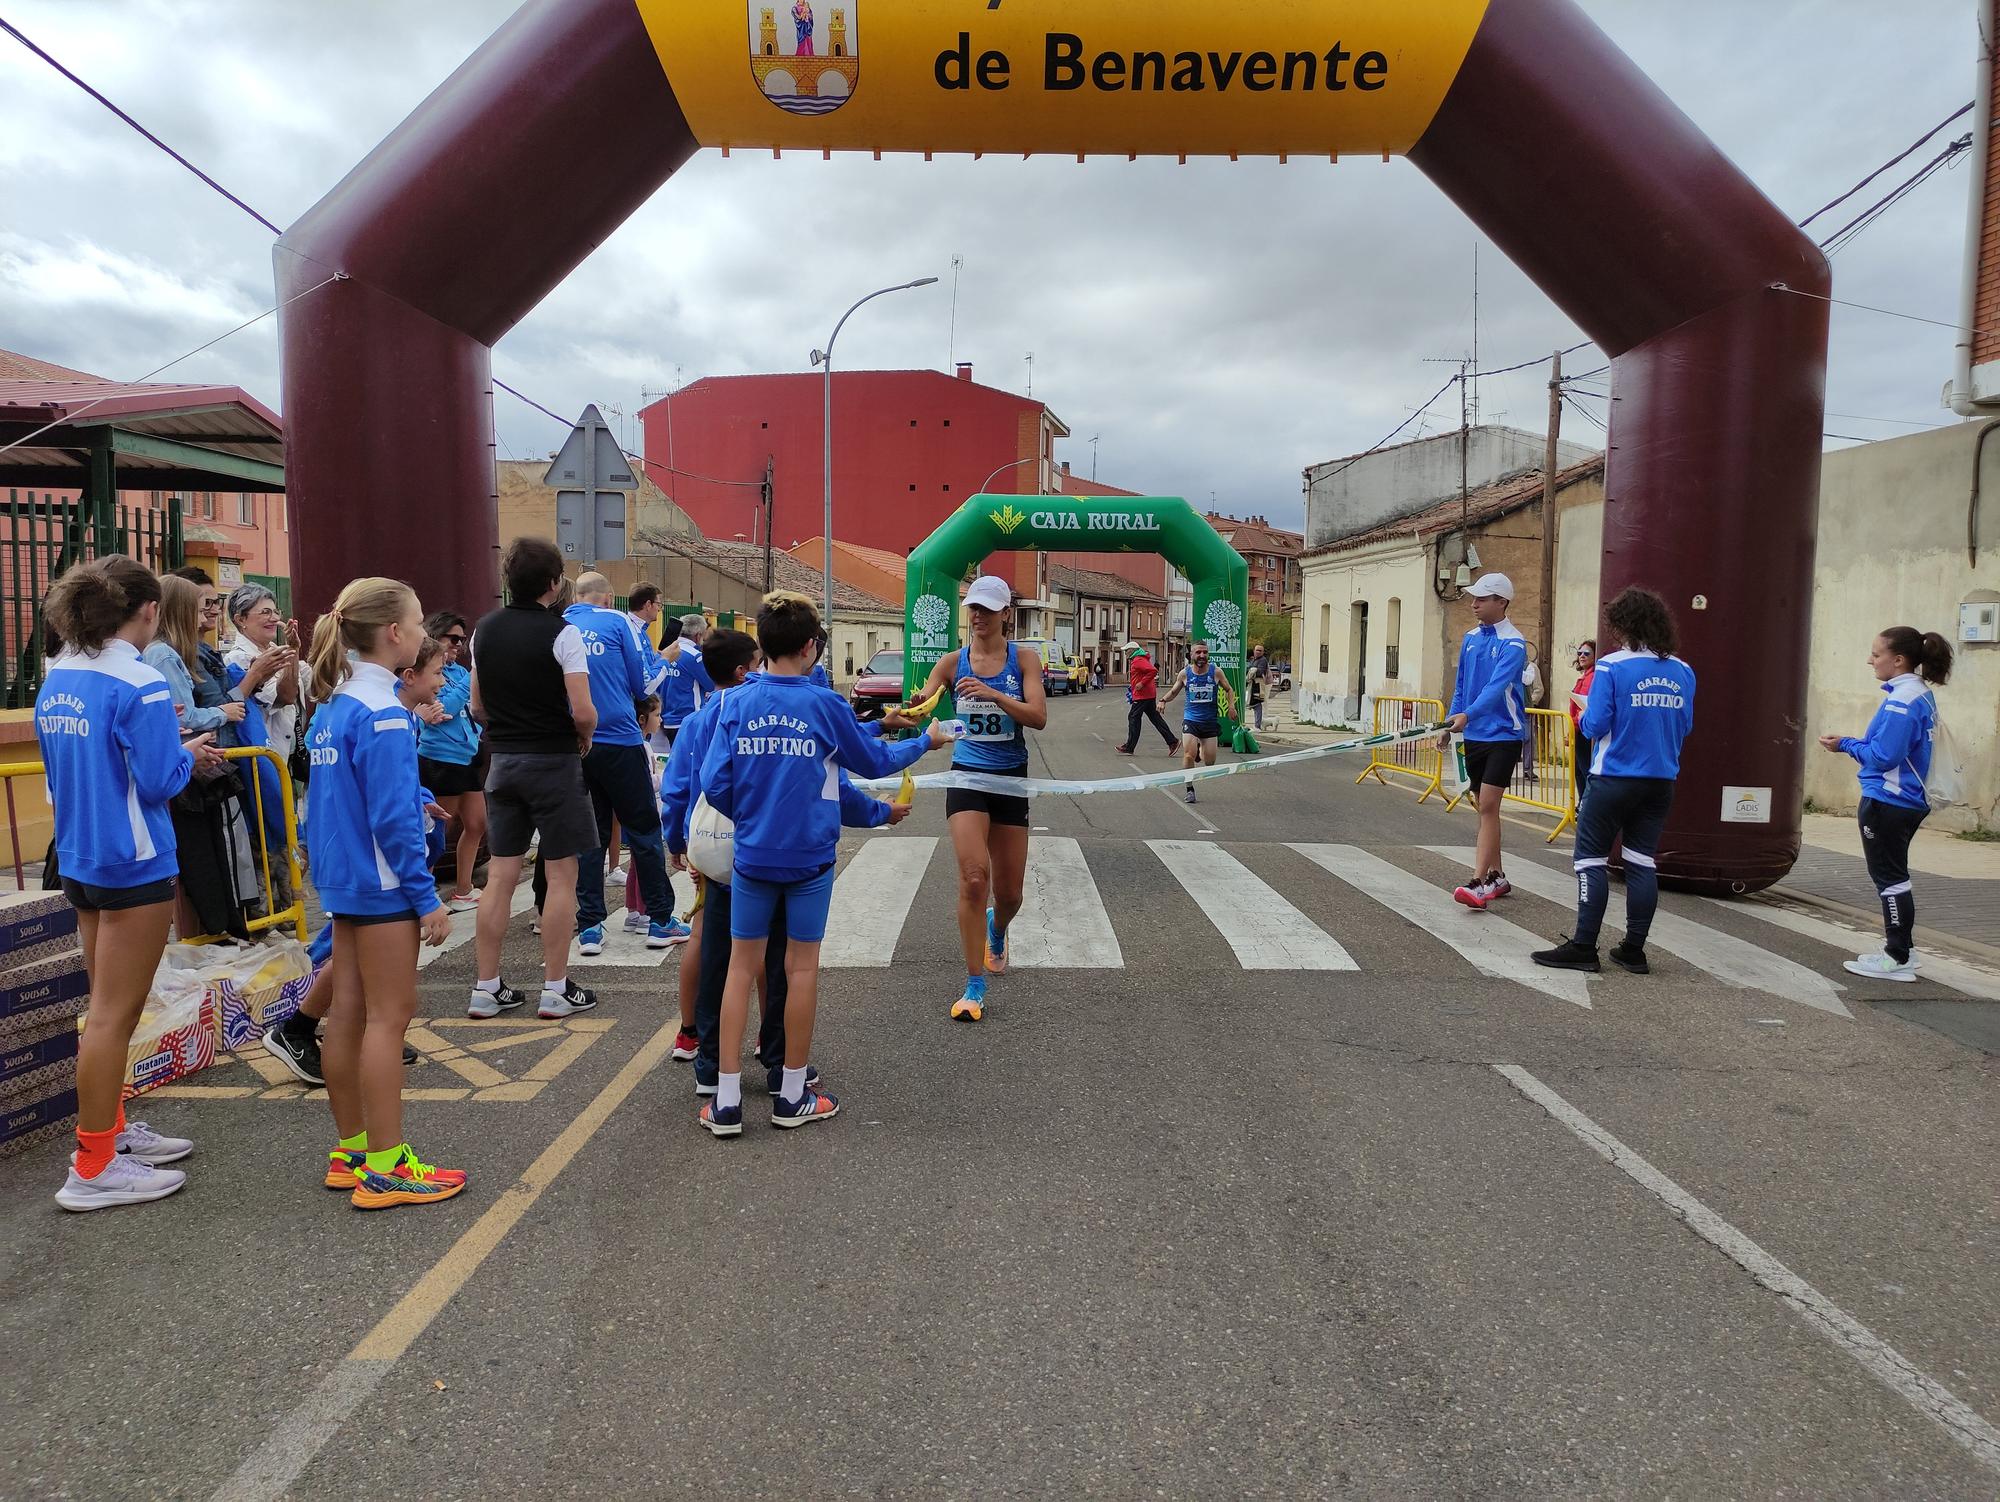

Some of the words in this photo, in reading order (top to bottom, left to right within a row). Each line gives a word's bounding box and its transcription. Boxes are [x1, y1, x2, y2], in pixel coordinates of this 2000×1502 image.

[934, 31, 1010, 91] de
[1044, 32, 1388, 92] Benavente
[1030, 511, 1081, 531] CAJA
[1087, 512, 1160, 531] RURAL
[1636, 676, 1681, 693] GARAJE
[42, 693, 85, 714] GARAJE
[1194, 691, 1208, 700] 42
[1630, 693, 1684, 709] RUFINO
[39, 715, 90, 737] RUFINO
[747, 714, 809, 734] GARAJE
[968, 713, 1002, 736] 58
[736, 737, 817, 758] RUFINO
[136, 1053, 171, 1074] Platania
